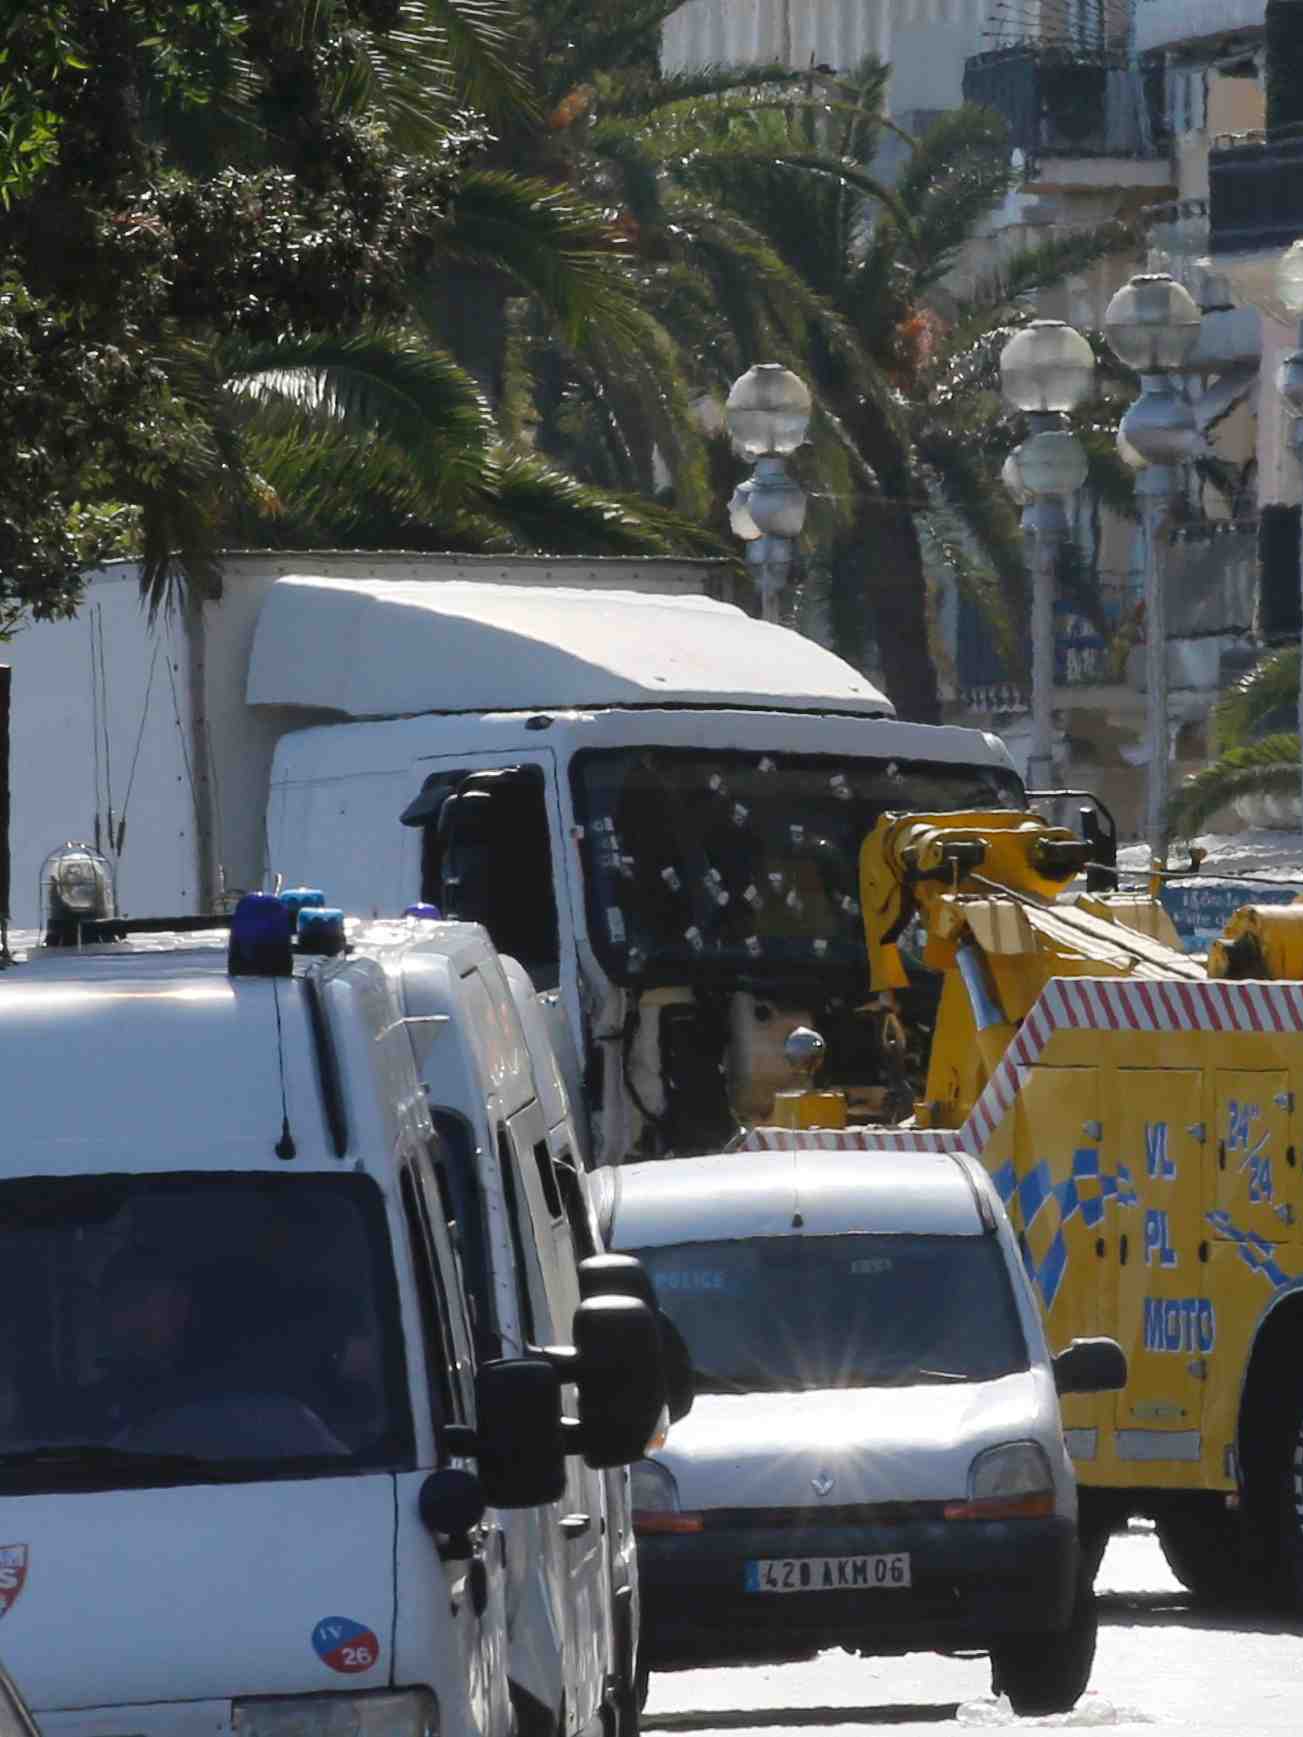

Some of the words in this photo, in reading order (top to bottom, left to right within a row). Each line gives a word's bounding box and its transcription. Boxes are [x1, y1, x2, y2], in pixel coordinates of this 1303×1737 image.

[1145, 1121, 1177, 1180] VL
[1145, 1209, 1178, 1269] PL
[1143, 1296, 1217, 1355] MOTO
[341, 1646, 373, 1666] 26
